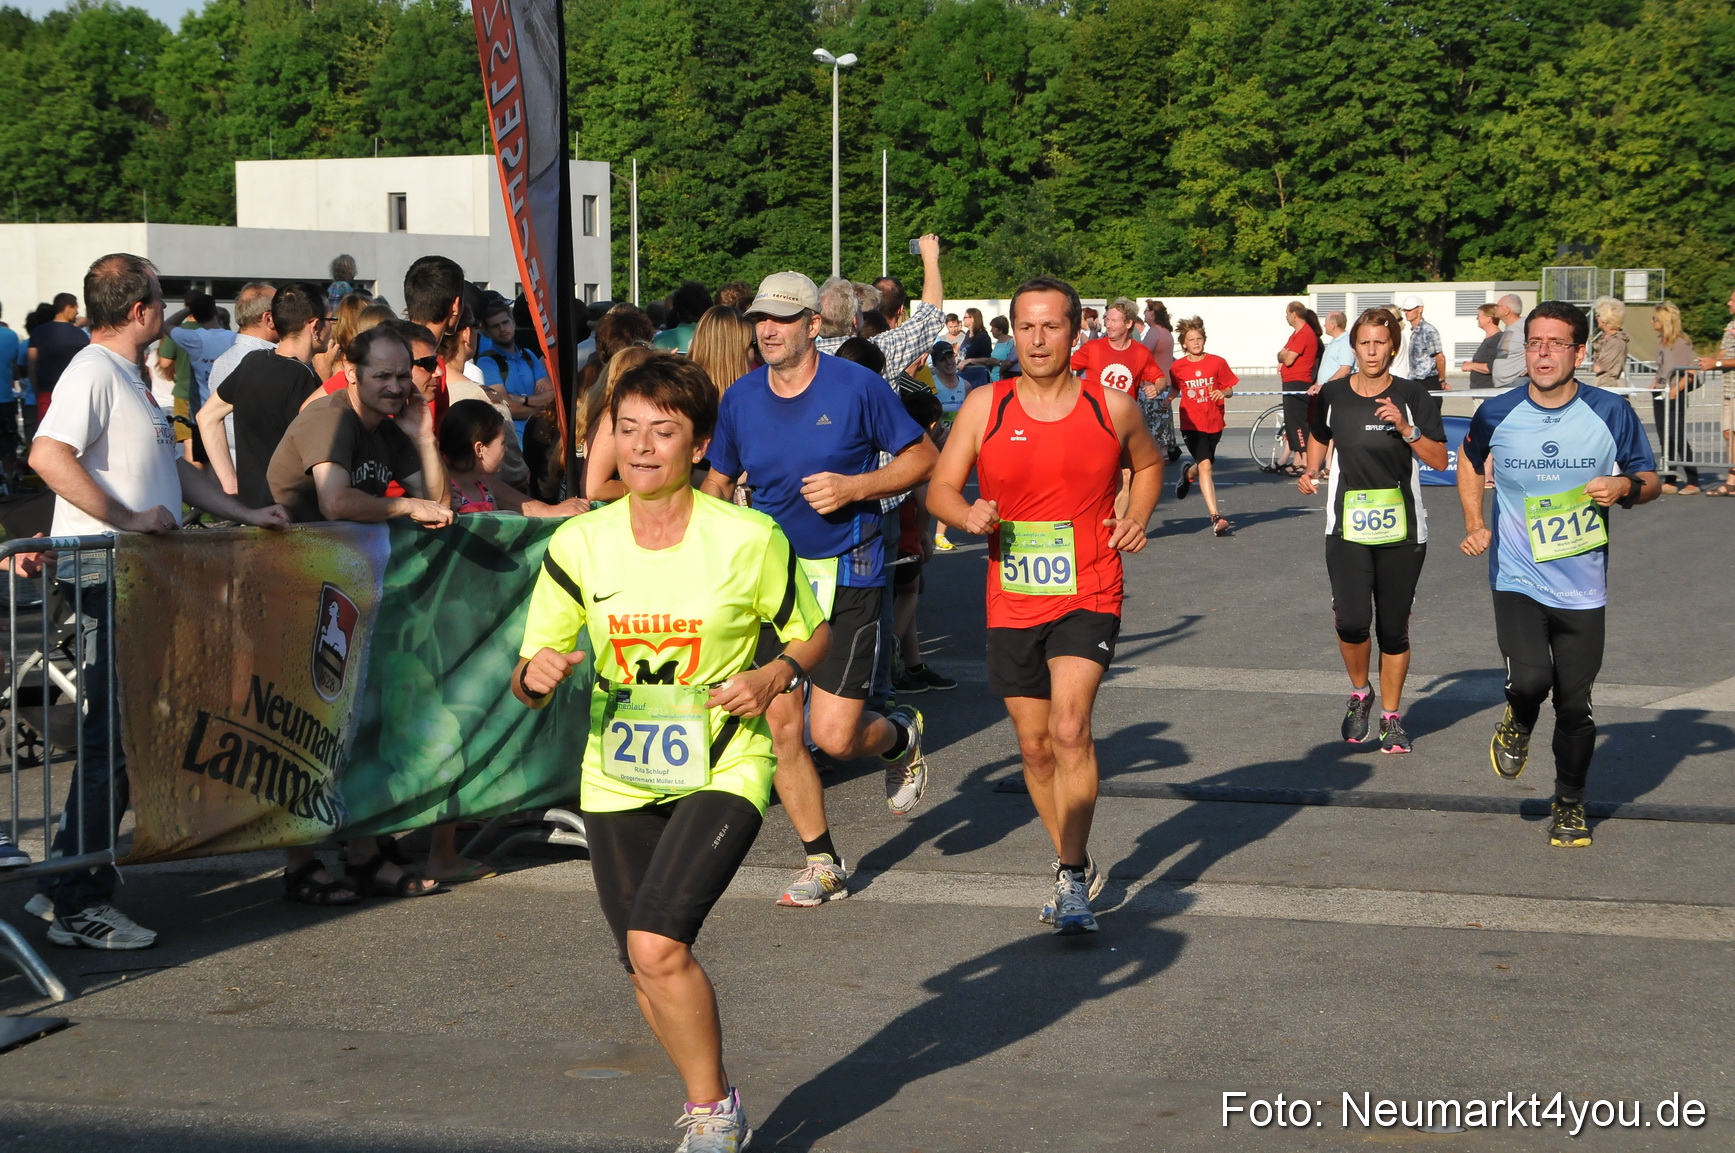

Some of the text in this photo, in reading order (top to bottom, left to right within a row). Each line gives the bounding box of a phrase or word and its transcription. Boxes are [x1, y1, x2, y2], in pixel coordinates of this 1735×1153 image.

[772, 293, 799, 302] services
[1103, 370, 1129, 390] 48
[1185, 377, 1214, 388] TRIPLE
[1504, 457, 1596, 470] SCHABMÜLLER
[1536, 474, 1560, 482] TEAM
[1352, 508, 1397, 532] 965
[1531, 505, 1600, 545] 1212
[1004, 555, 1071, 585] 5109
[607, 614, 703, 635] Müller
[317, 669, 336, 693] 1628
[611, 721, 690, 767] 276
[634, 766, 670, 776] Rita Schlupf
